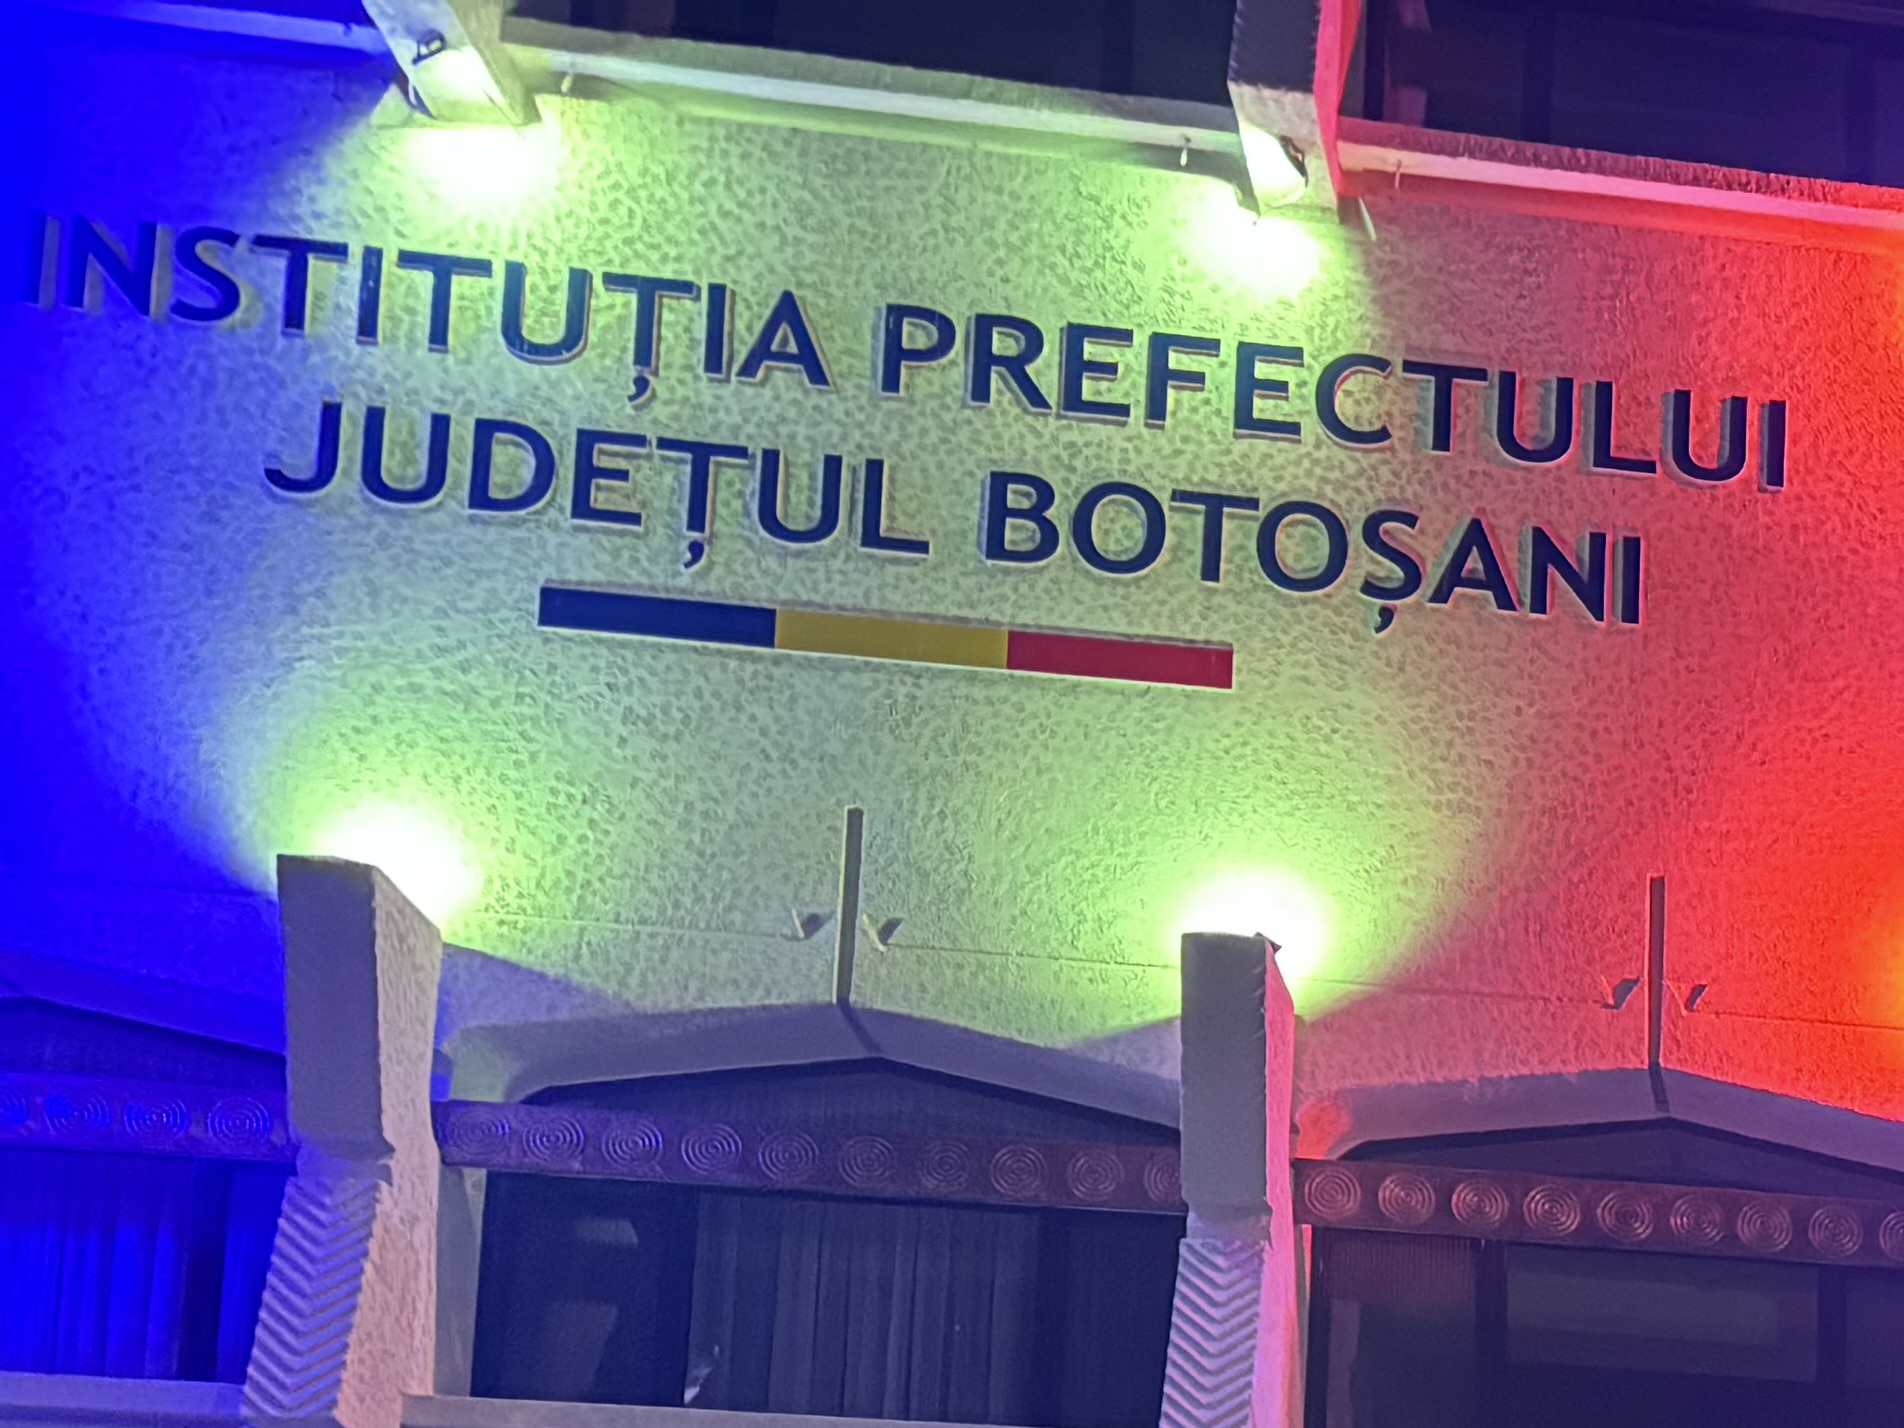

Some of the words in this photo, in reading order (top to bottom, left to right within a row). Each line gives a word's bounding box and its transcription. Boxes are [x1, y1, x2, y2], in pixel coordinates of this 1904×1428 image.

[25, 211, 833, 403] INSTITUȚIA
[875, 302, 1788, 491] PREFECTULUI
[263, 401, 931, 569] JUDEȚUL
[984, 469, 1642, 634] BOTOȘANI
